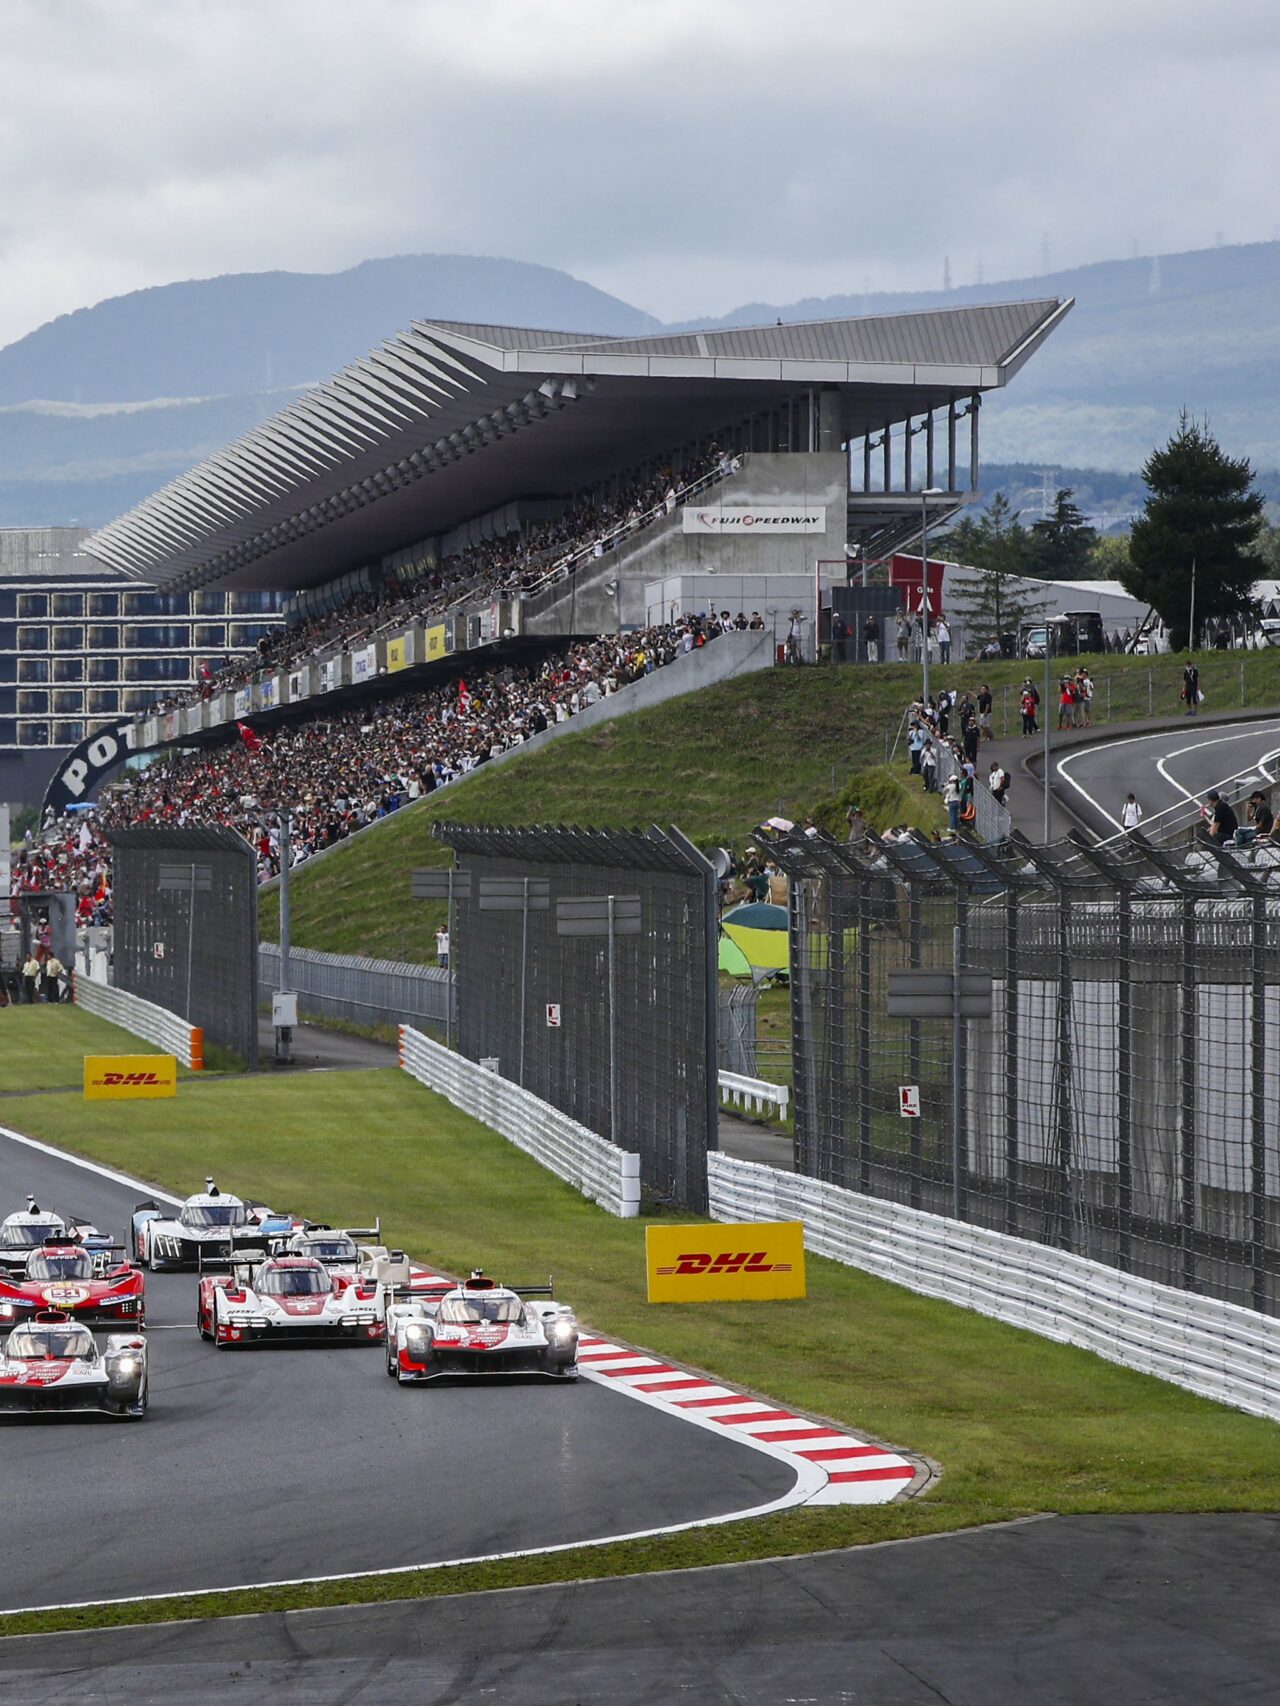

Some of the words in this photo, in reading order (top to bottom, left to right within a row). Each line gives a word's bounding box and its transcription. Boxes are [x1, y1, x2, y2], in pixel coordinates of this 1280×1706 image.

[103, 1072, 160, 1086] DHL
[675, 1252, 773, 1275] DHL
[52, 1289, 78, 1298] 51
